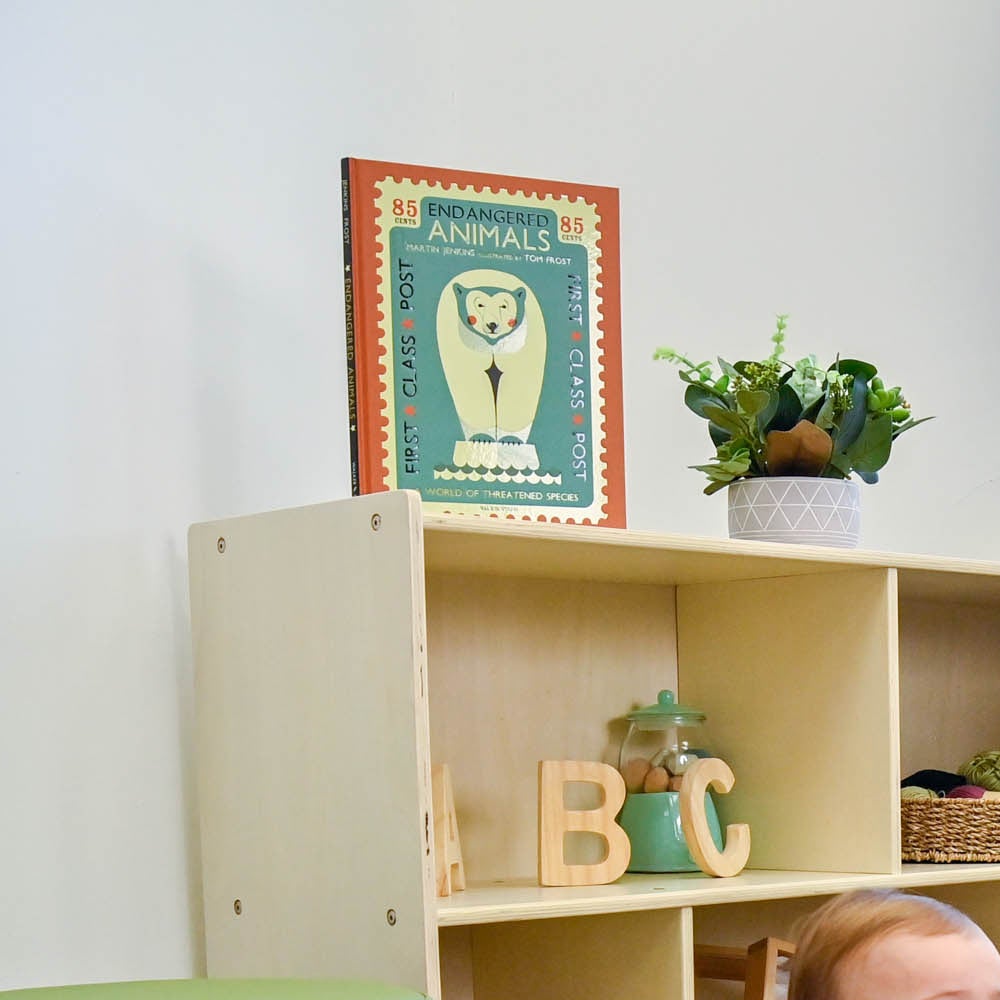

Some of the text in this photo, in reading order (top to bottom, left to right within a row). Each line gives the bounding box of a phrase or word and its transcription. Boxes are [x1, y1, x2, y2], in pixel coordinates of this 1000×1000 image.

[392, 198, 418, 218] 85
[428, 203, 549, 228] ENDANGERED
[394, 217, 417, 226] CENTS
[560, 216, 584, 234] 85
[428, 219, 551, 252] ANIMALS
[561, 234, 583, 242] CENTS
[405, 243, 440, 253] MARTIN
[443, 246, 476, 257] JENKINS
[524, 254, 544, 263] TOM
[546, 256, 572, 265] FROST
[345, 277, 357, 420] ENDANGERED ANIMALS
[398, 257, 419, 474] FIRST CLASS POST
[567, 273, 587, 482] FIRST CLASS POST
[424, 487, 580, 503] WORLD OF THREATENED SPECIES
[538, 759, 631, 887] B
[679, 757, 751, 878] C
